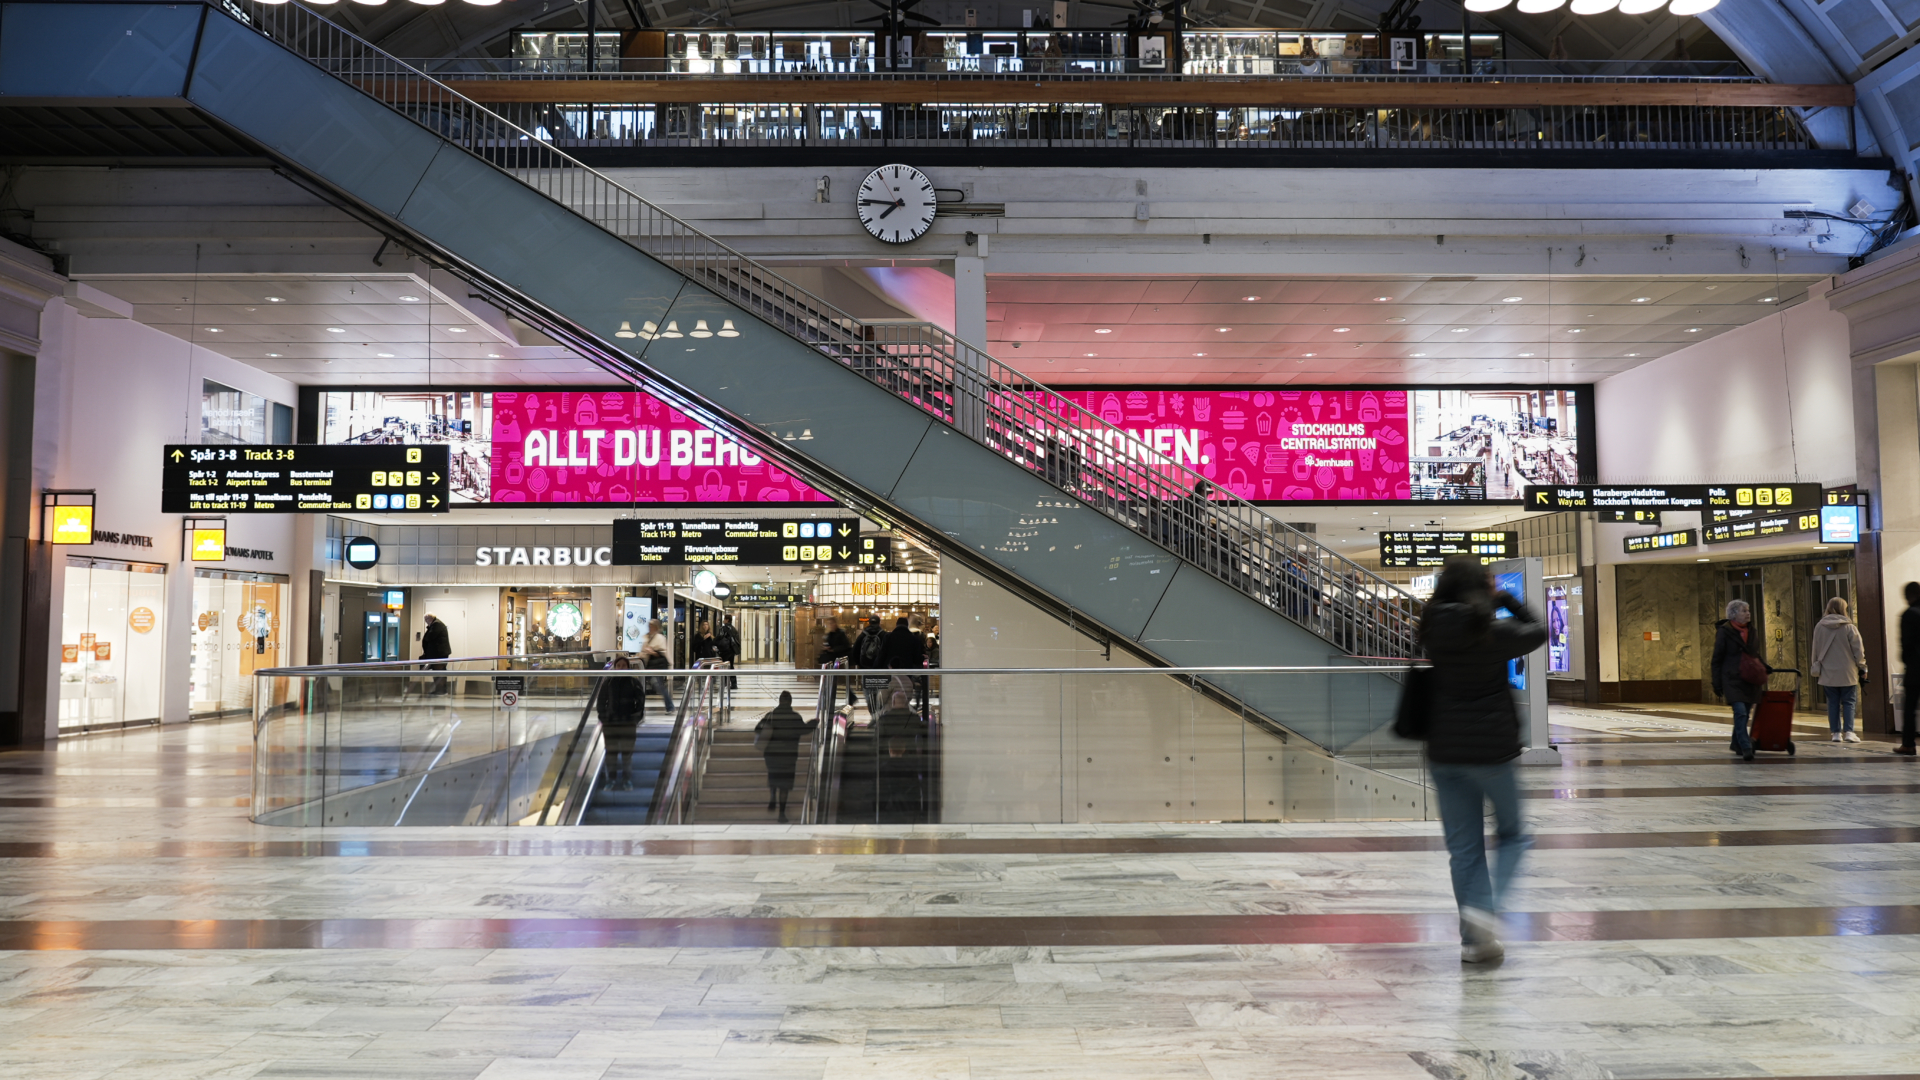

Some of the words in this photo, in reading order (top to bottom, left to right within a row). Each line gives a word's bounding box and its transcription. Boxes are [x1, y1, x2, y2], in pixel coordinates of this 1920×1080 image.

[1292, 424, 1365, 436] STOCKHOLMS
[524, 430, 605, 466] ALLT
[614, 430, 661, 466] DU
[1281, 438, 1376, 449] CENTRALSTATION
[191, 449, 216, 463] Spår
[218, 450, 237, 460] 3-8
[244, 449, 273, 460] Track
[276, 450, 294, 460] 3-8
[1314, 458, 1353, 467] Jernhusen
[189, 470, 204, 479] Spår
[254, 471, 279, 479] Express
[226, 479, 250, 487] Airport
[1558, 489, 1584, 498] Utgång
[1593, 489, 1665, 498] Klarabergsviadukten
[1709, 488, 1726, 496] Polis
[298, 493, 332, 502] Pendeltåg
[1593, 497, 1630, 505] Stockholm
[1631, 497, 1670, 505] Waterfront
[1671, 498, 1702, 507] Kongress
[1558, 498, 1574, 507] Way
[640, 522, 656, 531] Spår
[682, 522, 720, 530] Tunnelbana
[725, 522, 759, 531] Pendeltåg
[121, 534, 153, 547] APOTEK
[640, 545, 670, 553] Toaletter
[684, 545, 738, 555] Förvaringsboxar
[250, 549, 274, 560] APOTEK
[476, 546, 612, 566] STARBUC
[684, 554, 713, 562] Luggage
[850, 582, 891, 596] WIGGO!
